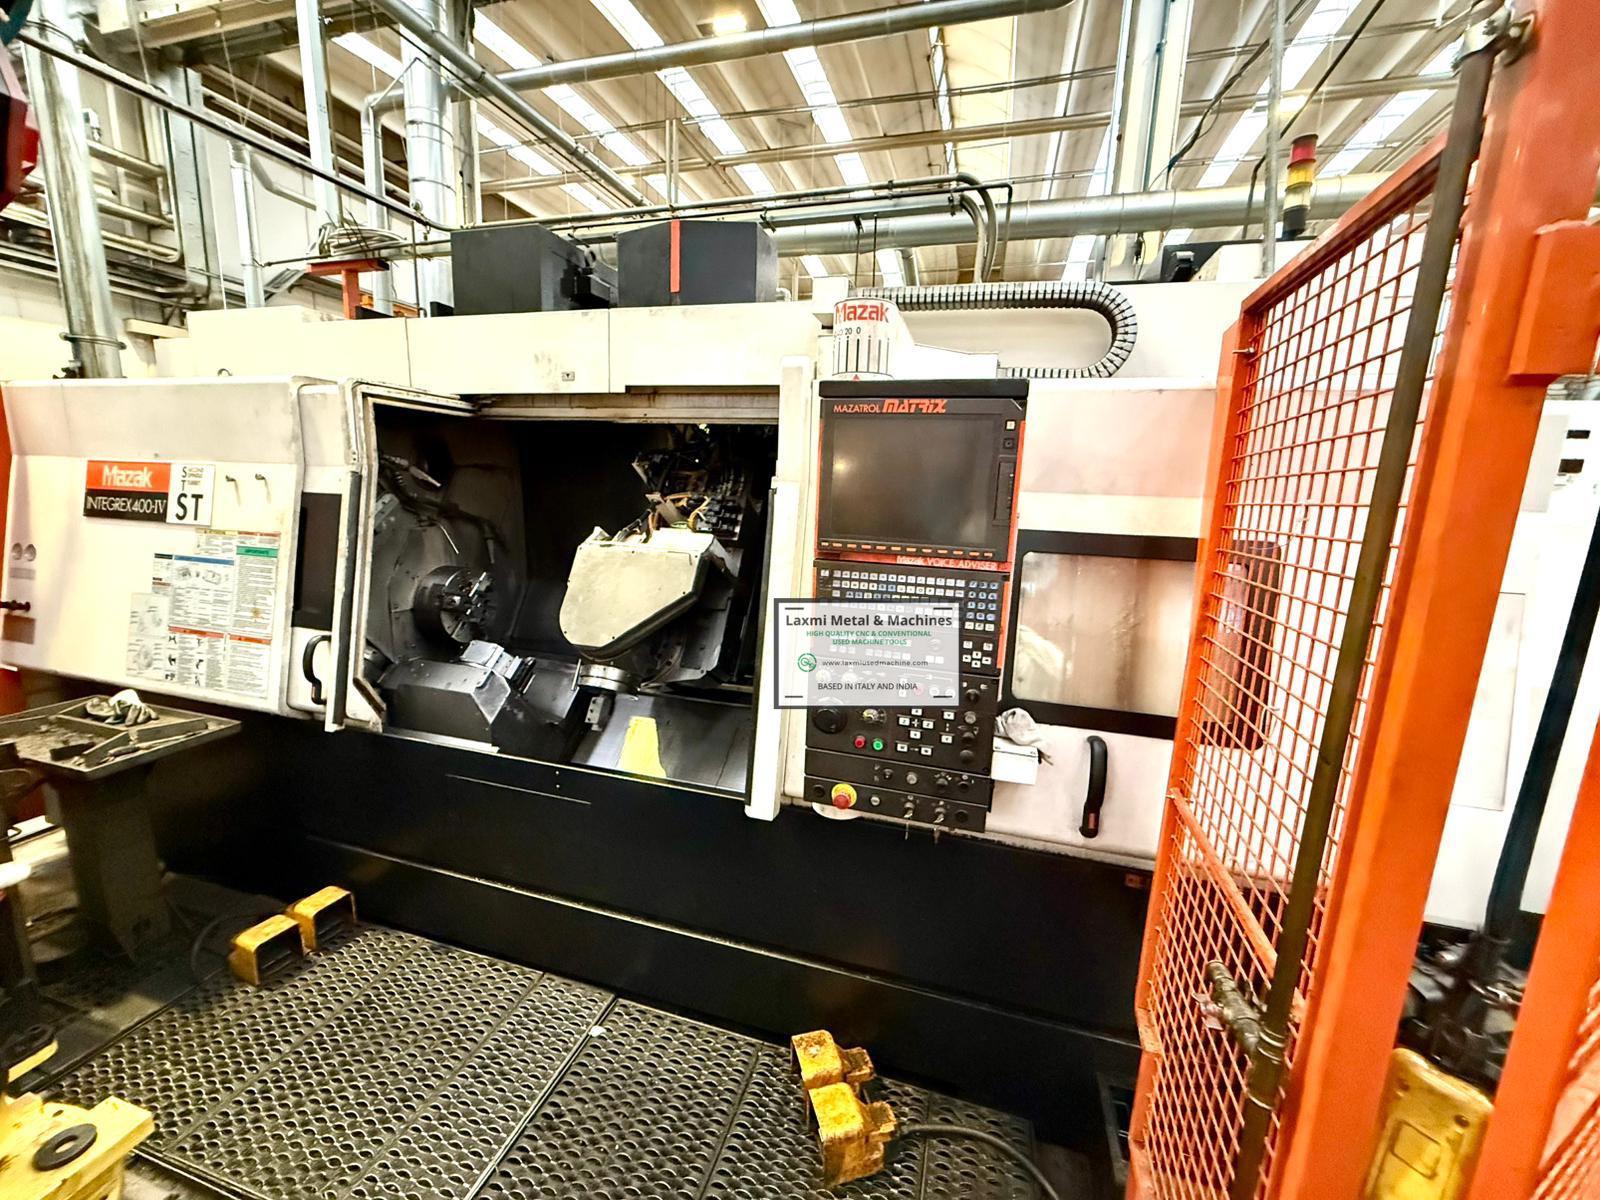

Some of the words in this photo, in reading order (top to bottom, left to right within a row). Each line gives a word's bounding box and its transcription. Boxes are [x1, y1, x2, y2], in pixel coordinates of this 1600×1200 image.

[835, 302, 889, 324] Mazak
[845, 327, 854, 335] 20
[856, 326, 861, 335] 0
[833, 404, 881, 413] MAZATROL
[881, 399, 947, 414] MATRIX
[102, 464, 153, 489] Mazak
[181, 466, 188, 478] S
[175, 492, 204, 521] ST
[927, 557, 956, 568] VOICE
[958, 560, 998, 571] ADVISER
